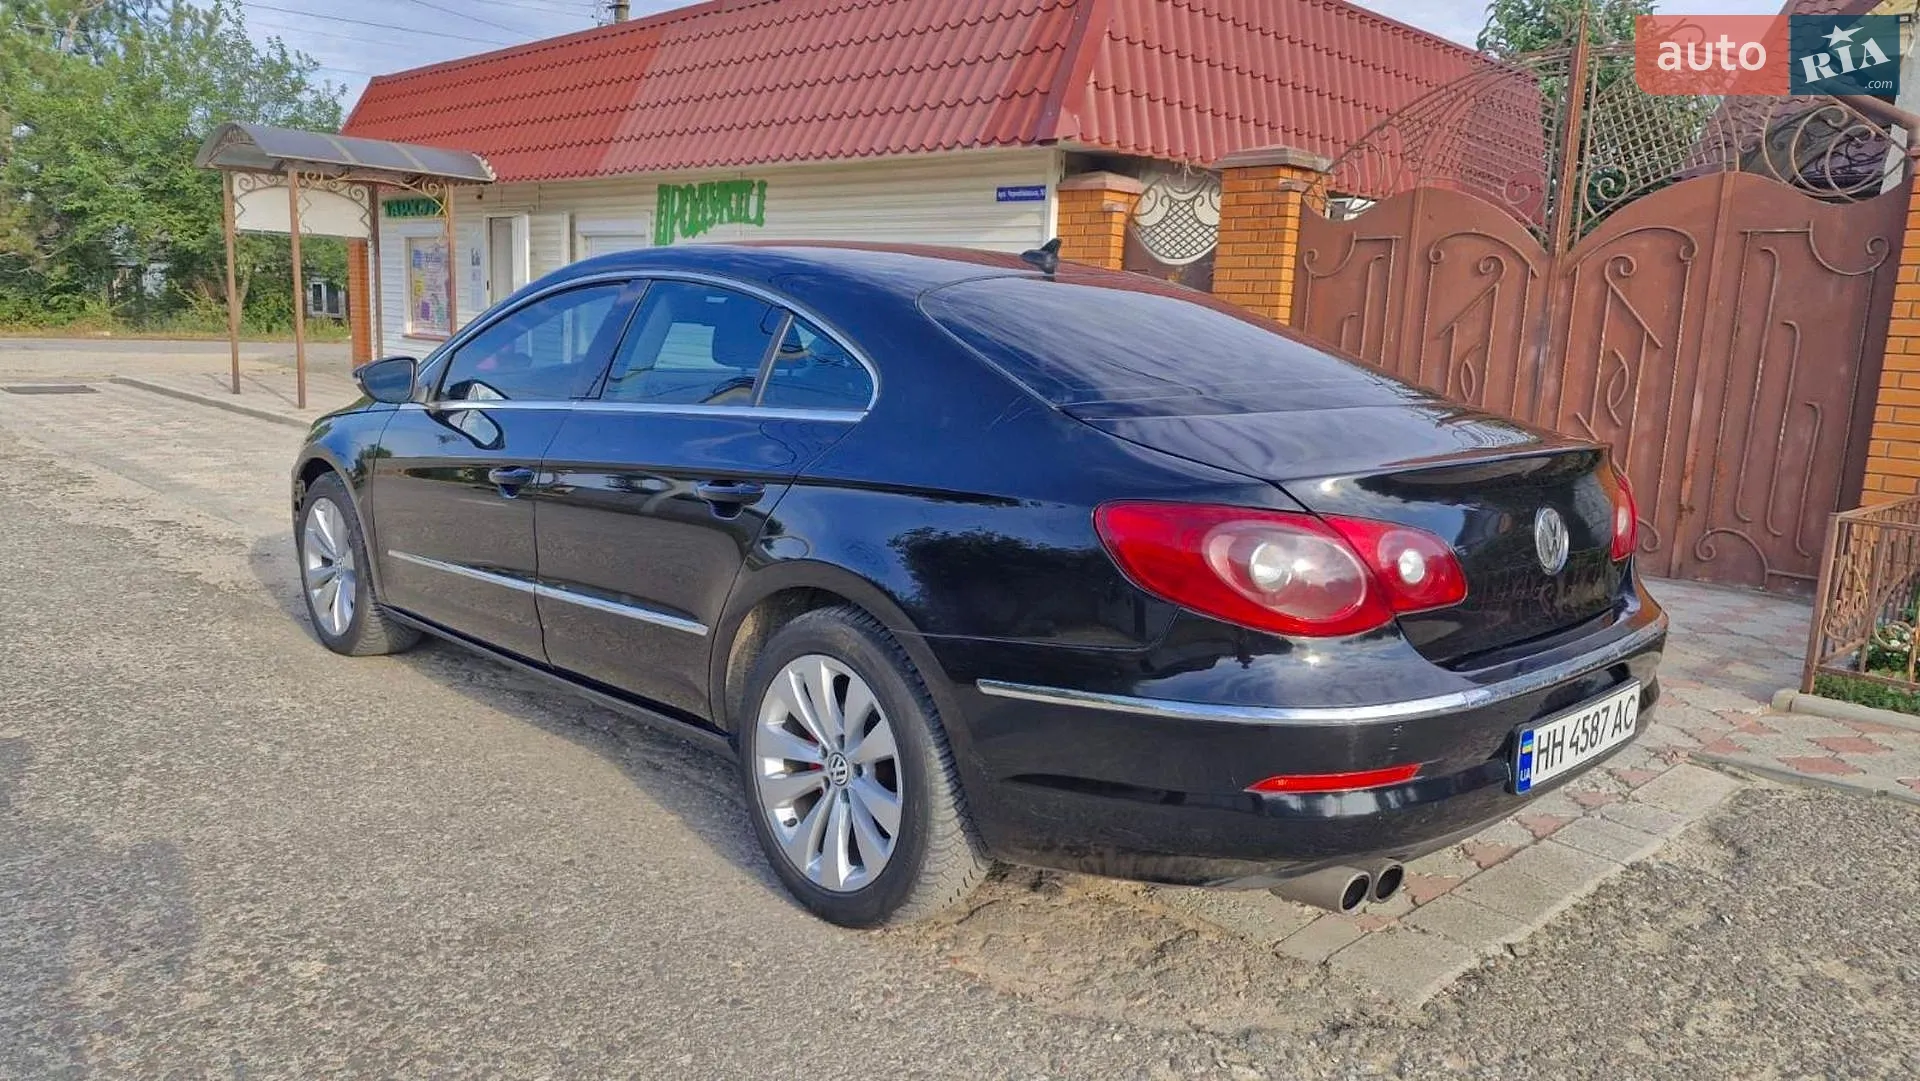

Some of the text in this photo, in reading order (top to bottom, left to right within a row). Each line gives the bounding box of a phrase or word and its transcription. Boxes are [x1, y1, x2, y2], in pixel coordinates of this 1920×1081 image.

[1535, 695, 1636, 774] HH 4587 AC
